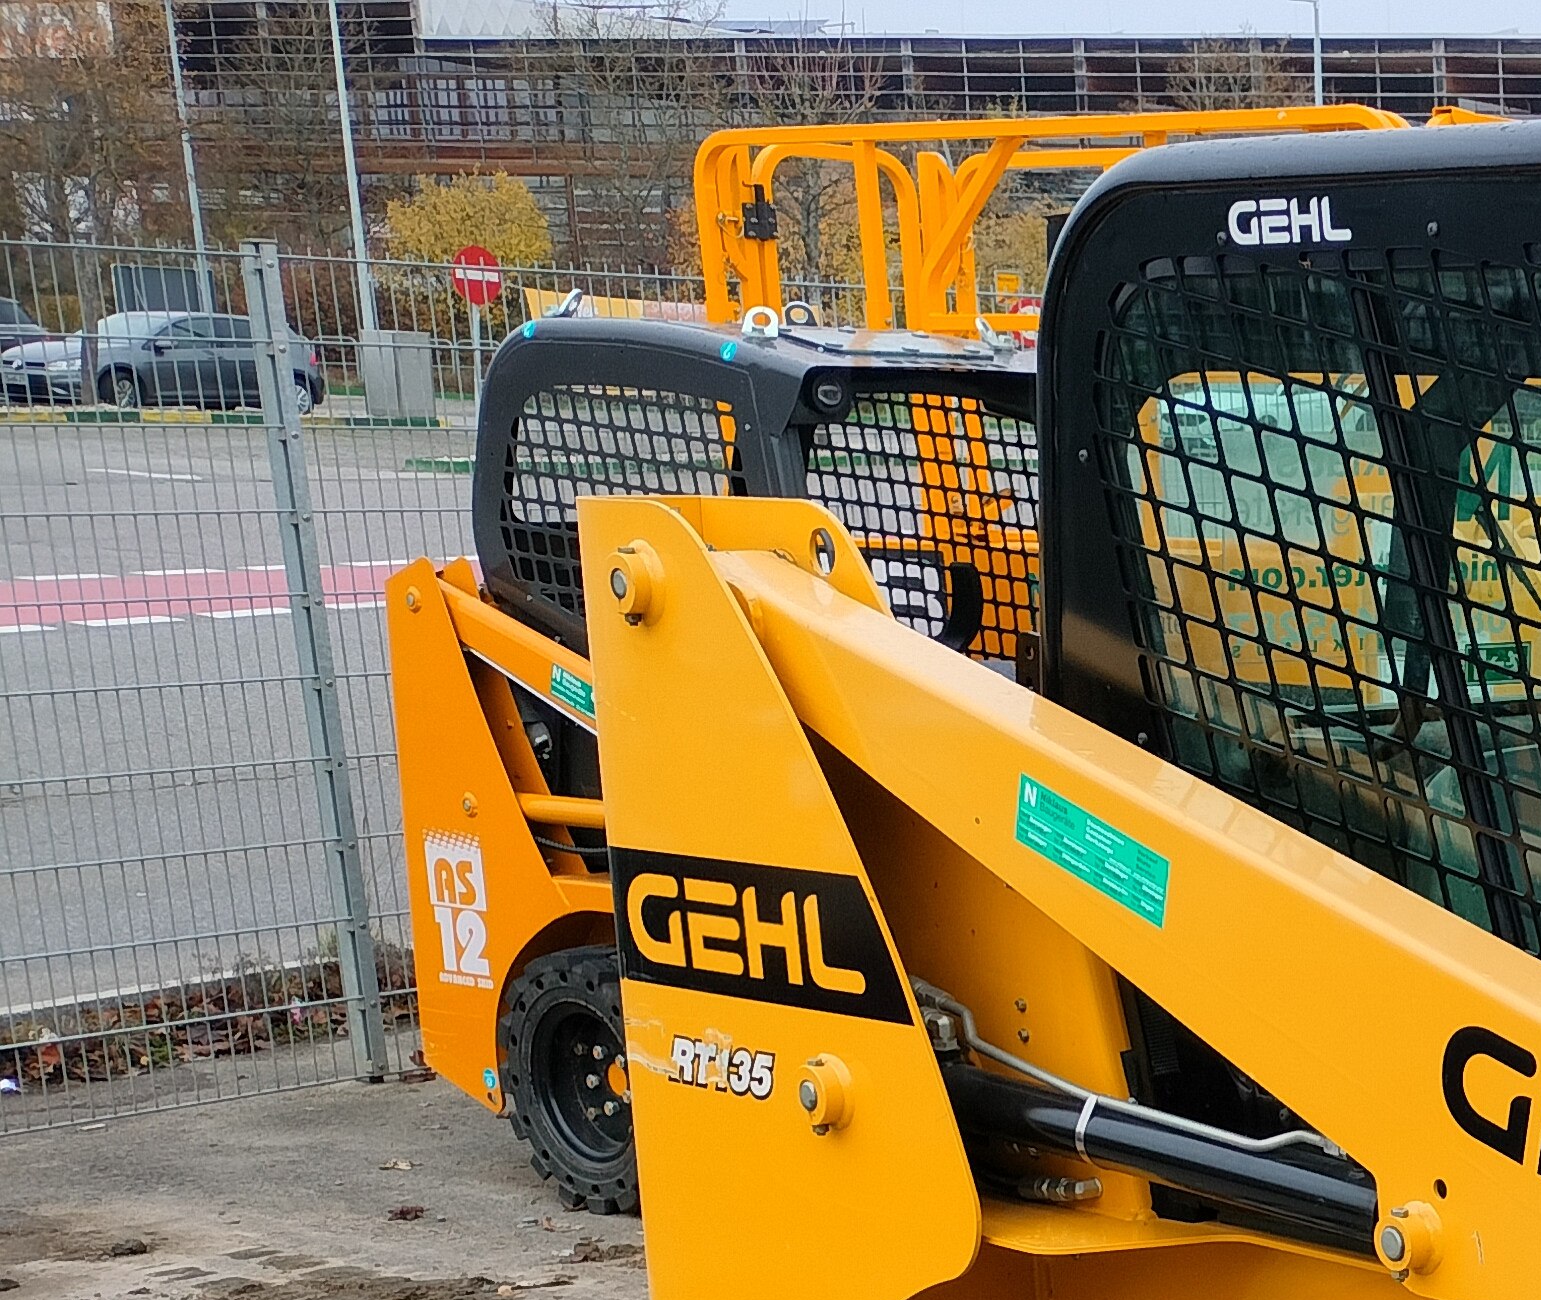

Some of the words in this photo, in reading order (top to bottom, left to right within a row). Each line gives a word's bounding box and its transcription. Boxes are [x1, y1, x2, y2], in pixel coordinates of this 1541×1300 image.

[1228, 196, 1352, 245] GEHL
[1023, 781, 1038, 808] N
[433, 857, 478, 906] AS
[434, 906, 491, 977] 12
[626, 872, 867, 995] GEHL
